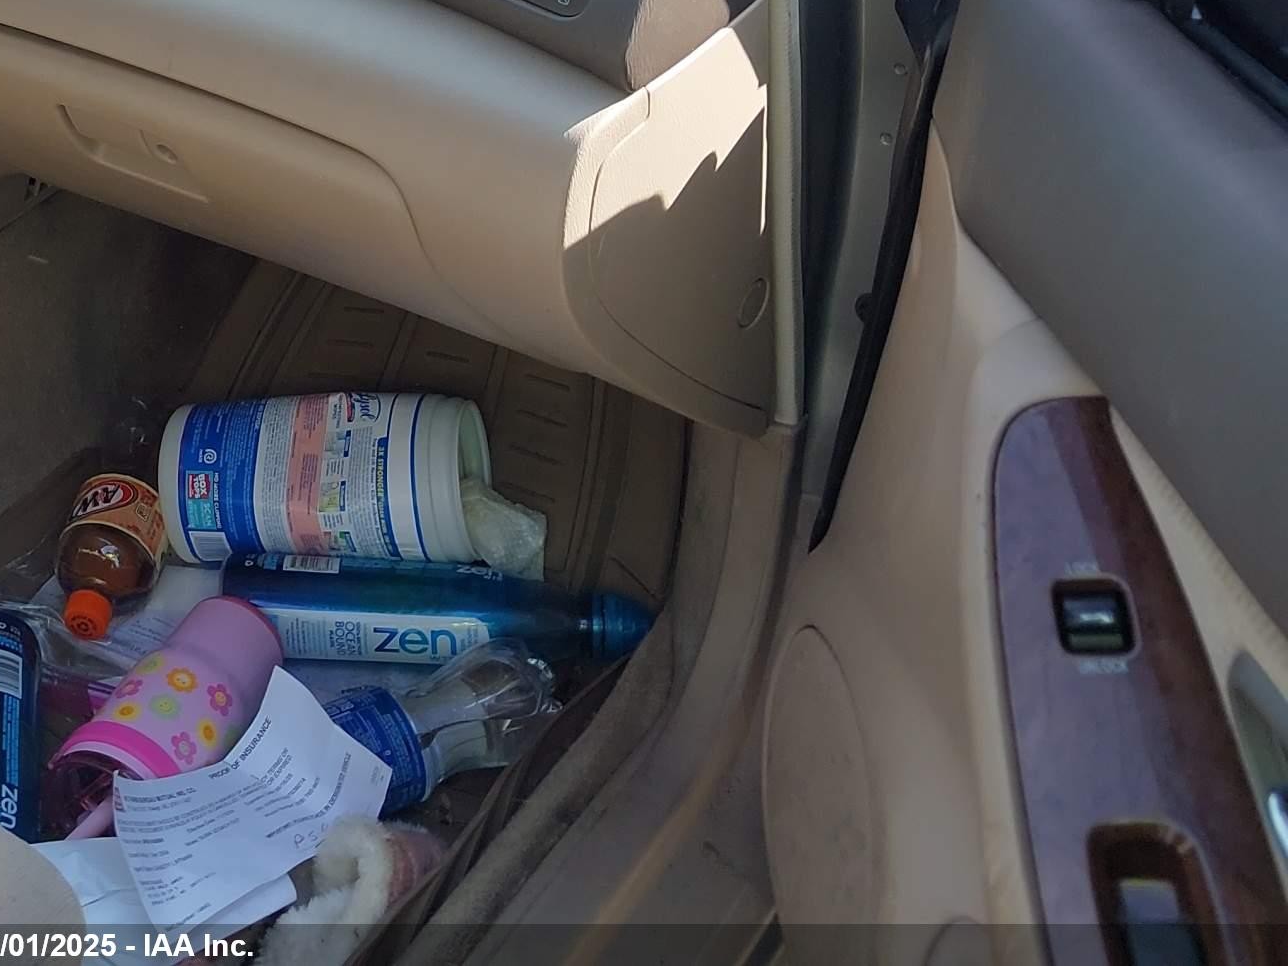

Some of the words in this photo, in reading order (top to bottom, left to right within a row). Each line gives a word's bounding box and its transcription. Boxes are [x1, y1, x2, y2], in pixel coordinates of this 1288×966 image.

[192, 476, 201, 499] TOPS
[197, 473, 207, 495] BOX
[376, 458, 385, 497] STRONGER
[334, 621, 346, 655] BOUND
[345, 621, 356, 655] OCEAN
[372, 627, 457, 656] zen
[209, 766, 231, 779] PROOF
[230, 757, 241, 770] OF
[240, 715, 272, 762] INSURANCE
[1, 784, 19, 830] zen
